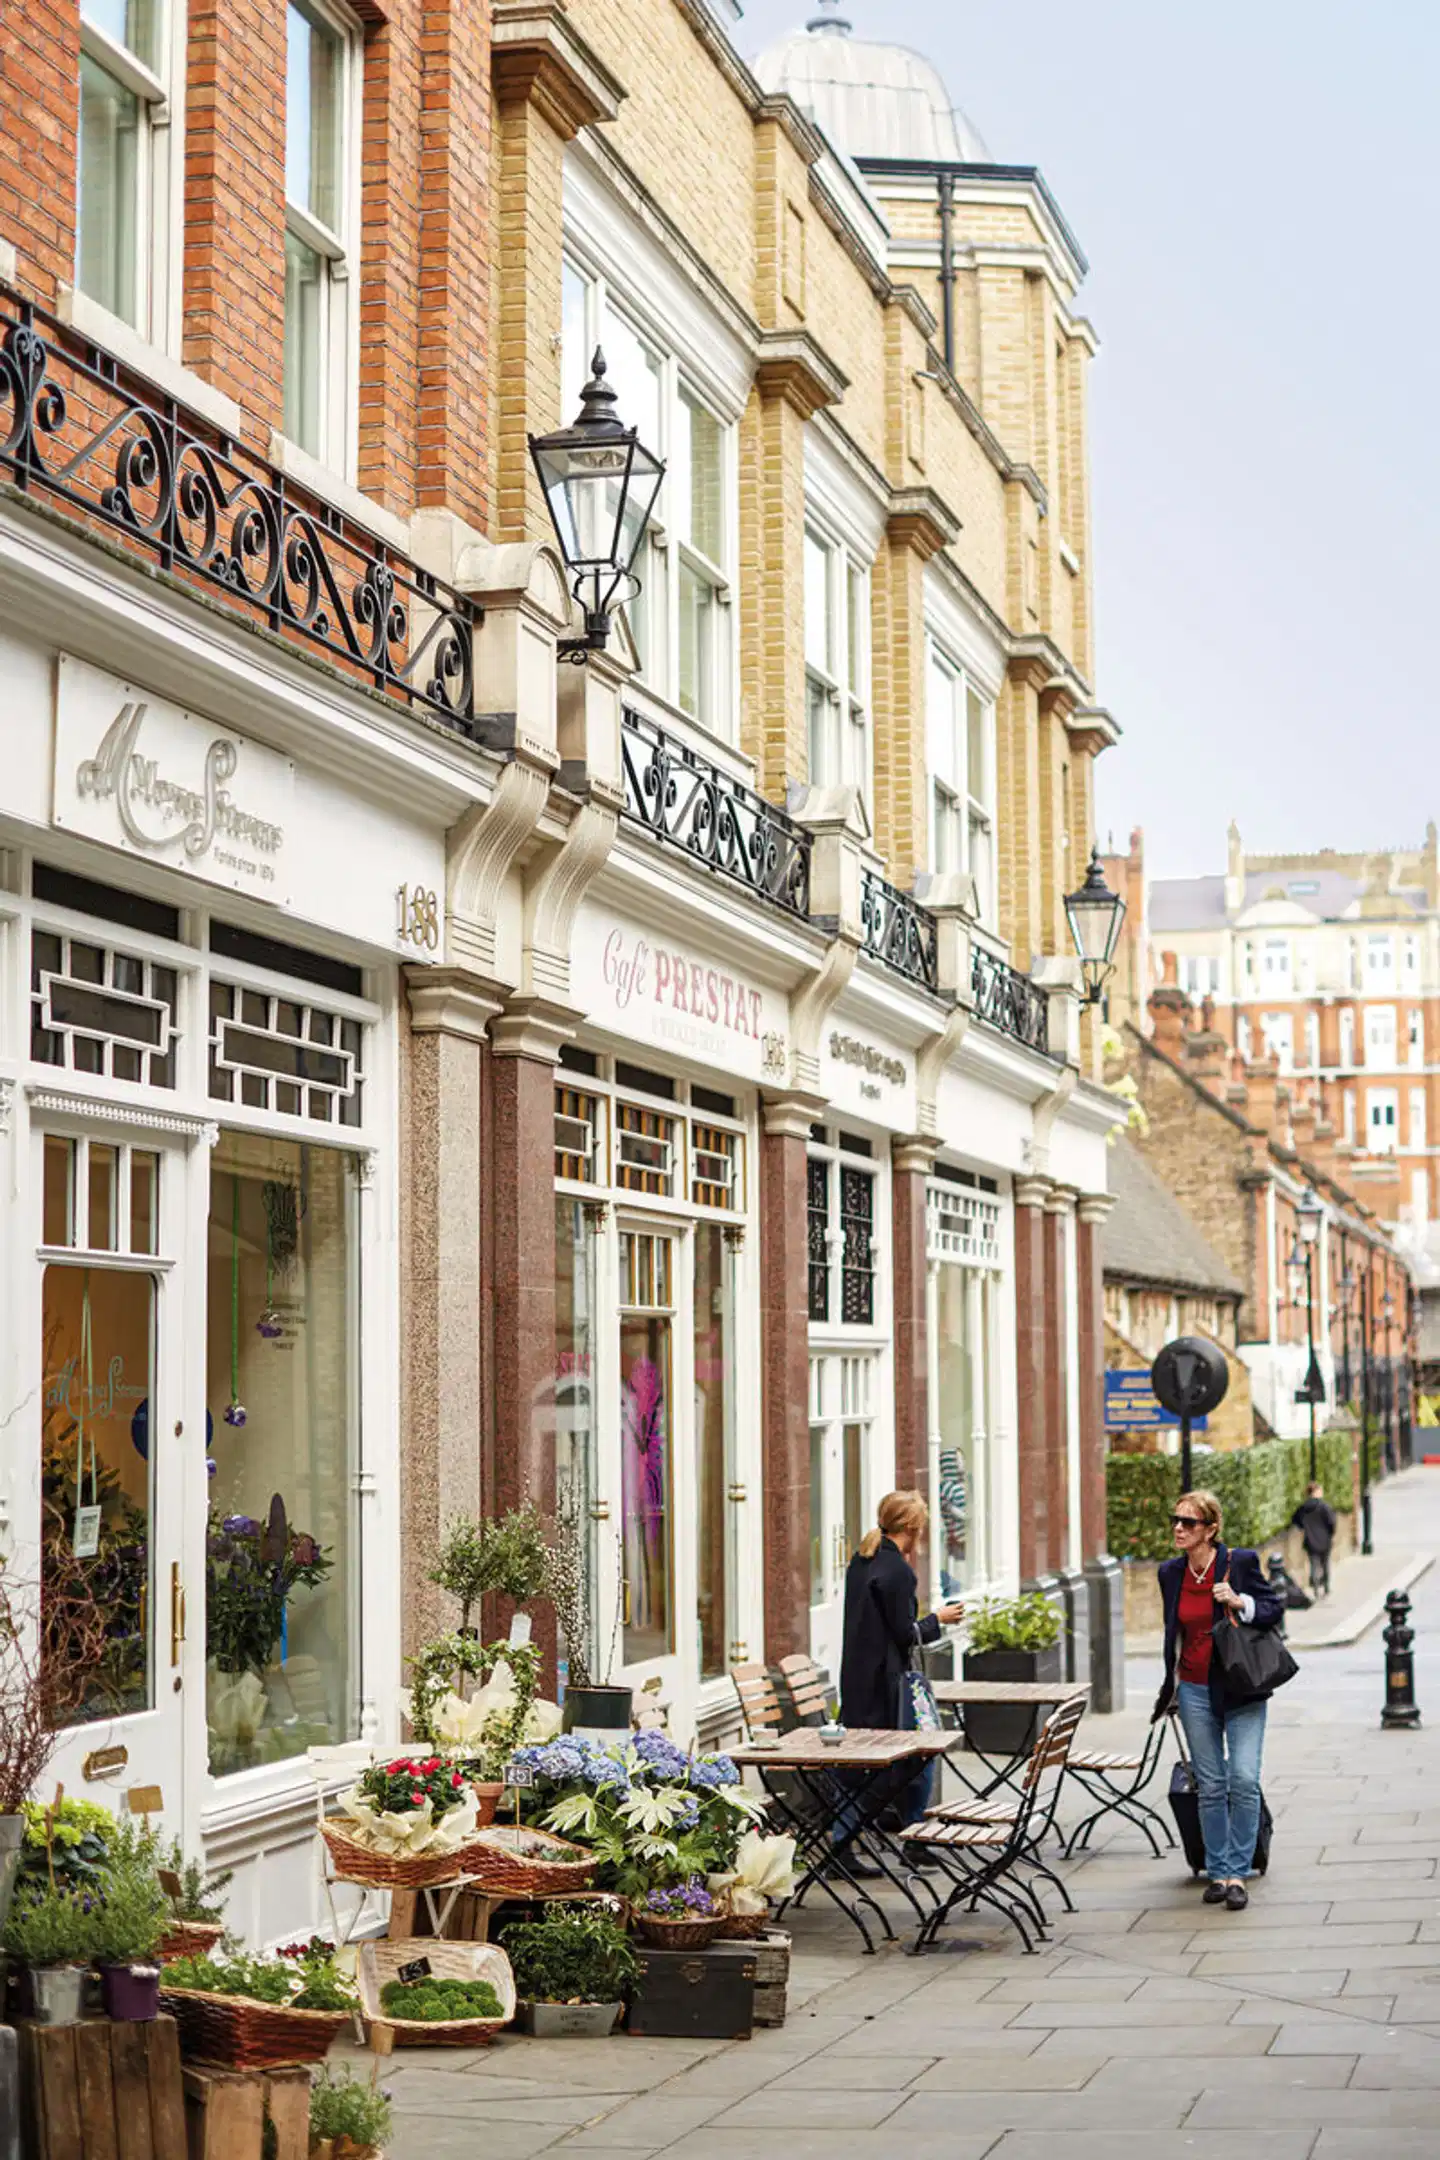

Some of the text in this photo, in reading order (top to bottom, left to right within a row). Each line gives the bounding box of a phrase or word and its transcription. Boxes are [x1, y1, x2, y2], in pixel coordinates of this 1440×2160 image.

[398, 882, 439, 951] 188
[603, 928, 649, 1009] Café
[654, 948, 763, 1040] PRESTAT
